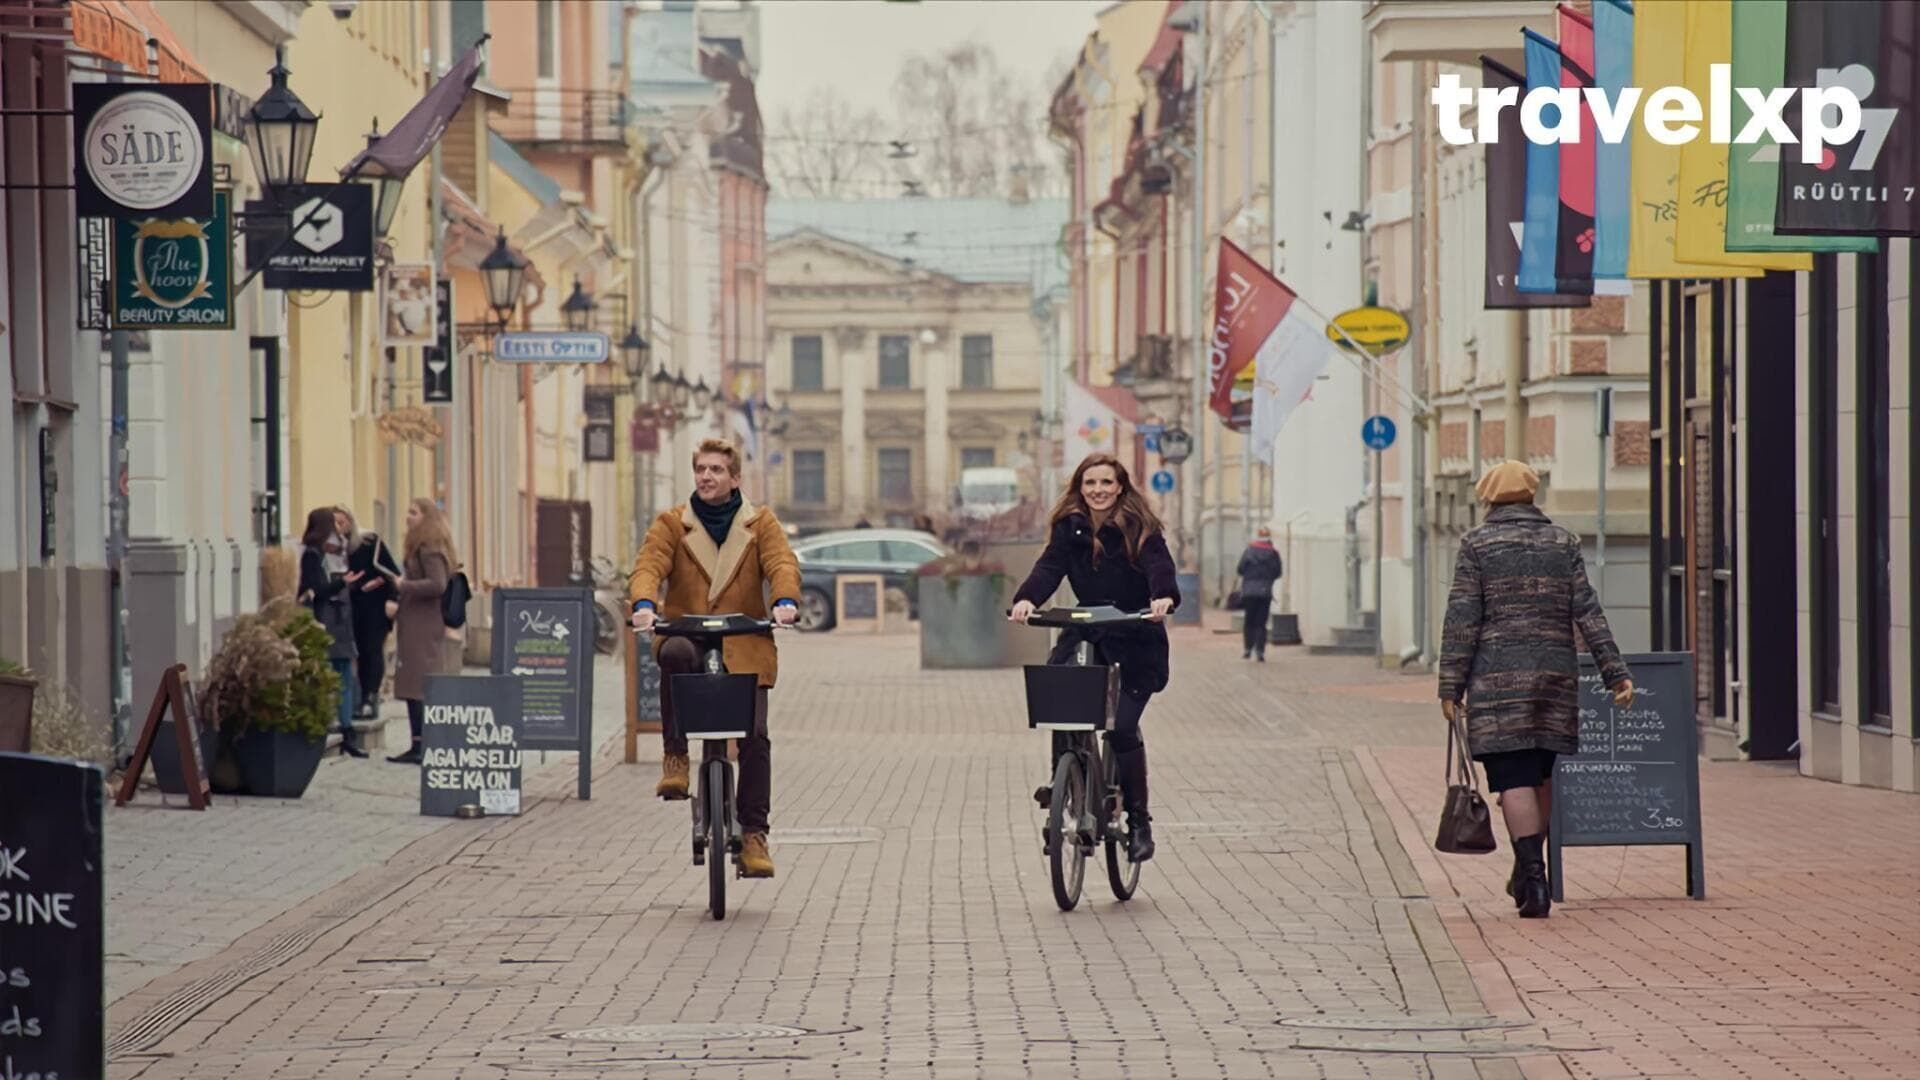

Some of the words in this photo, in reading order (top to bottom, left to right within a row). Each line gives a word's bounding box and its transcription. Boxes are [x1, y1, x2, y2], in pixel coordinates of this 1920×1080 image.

[101, 124, 184, 165] SÄDE
[1794, 182, 1888, 202] RÜÜTLI
[1903, 187, 1915, 202] 7
[309, 256, 366, 267] MARKET
[120, 308, 173, 322] BEAUTY
[177, 308, 225, 322] SALON
[424, 705, 495, 725] KOHVITA
[466, 725, 518, 748] SAAB,
[422, 747, 457, 769] AGA
[427, 768, 461, 790] SEE
